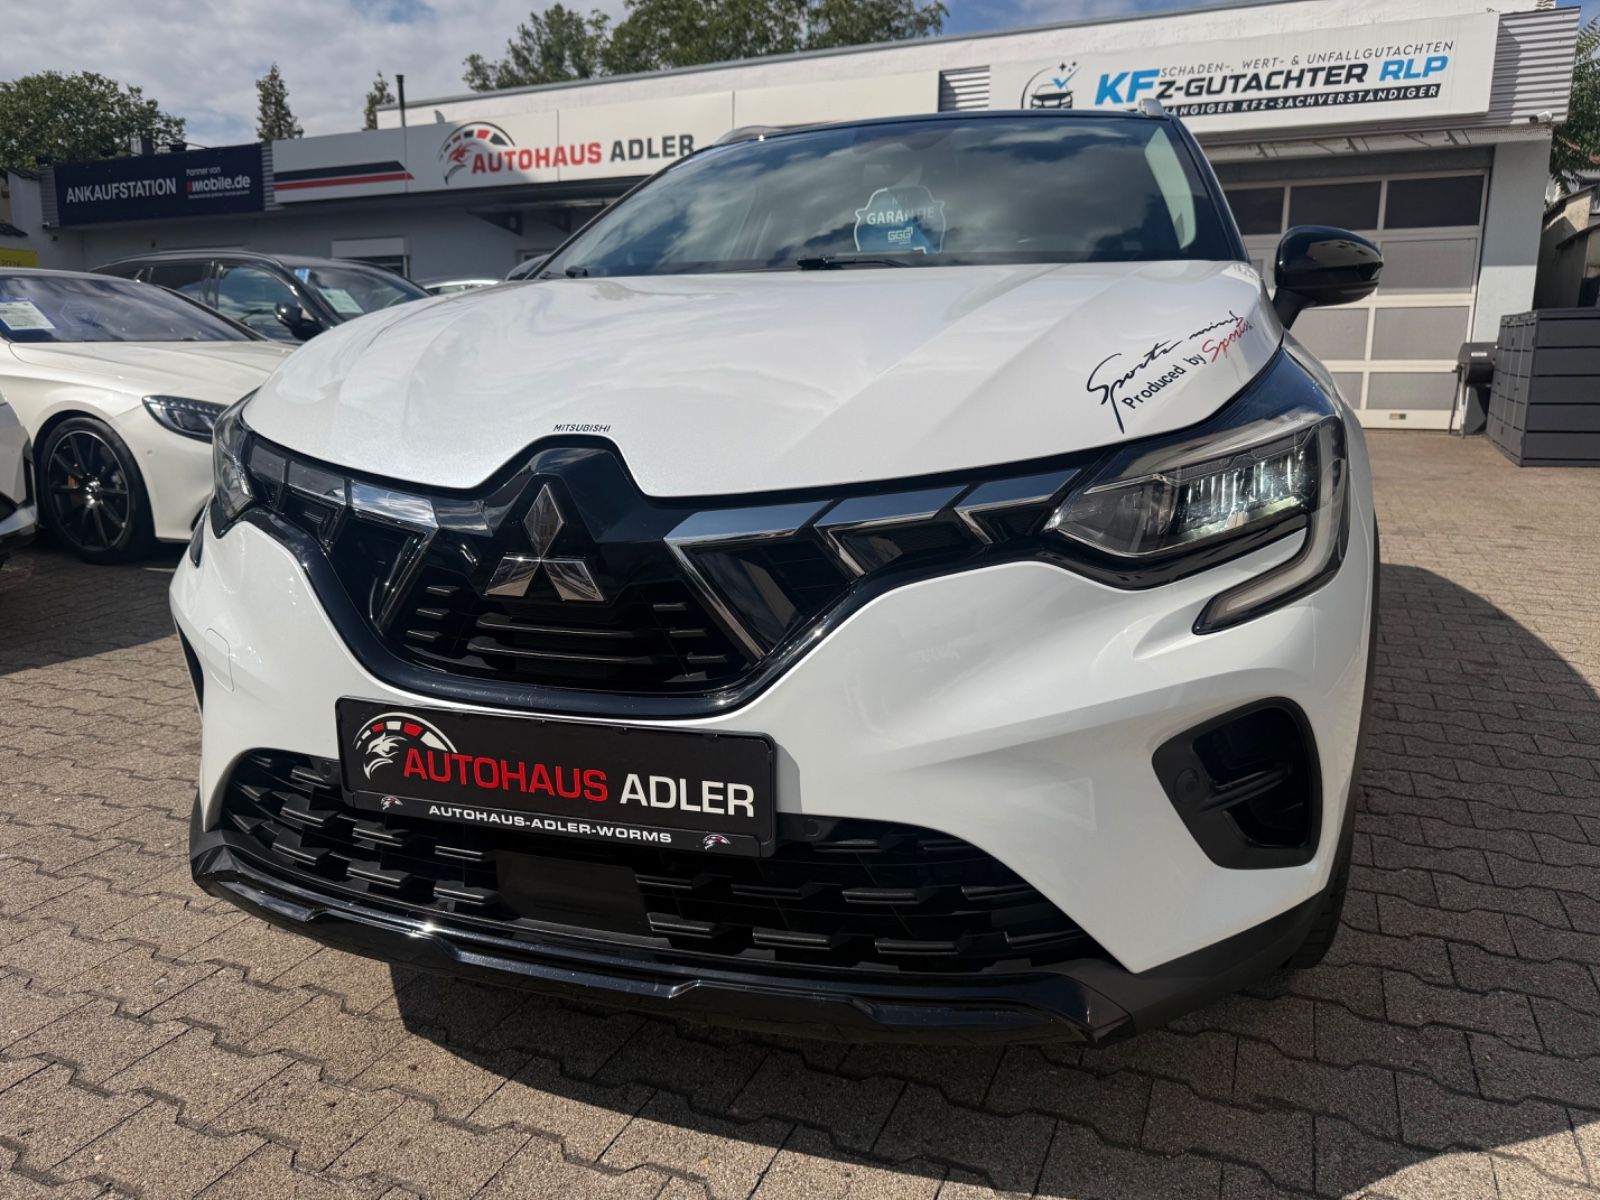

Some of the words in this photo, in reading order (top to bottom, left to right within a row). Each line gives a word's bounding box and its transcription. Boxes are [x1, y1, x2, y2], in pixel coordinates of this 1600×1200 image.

[1242, 56, 1285, 70] WERT-
[1291, 55, 1300, 66] &
[1307, 40, 1454, 65] UNFALLGUTACHTEN
[1379, 55, 1449, 82] RLP
[1241, 85, 1438, 112] KFZ-SACHVERSTÄNDIGER
[471, 142, 603, 174] AUTOHAUS
[609, 133, 695, 162] ADLER
[66, 177, 177, 203] ANKAUFSTATION
[191, 174, 251, 193] mobile.de
[1121, 364, 1188, 410] Produced
[1182, 353, 1207, 366] by
[553, 423, 612, 433] MITSUBISHI
[403, 747, 609, 802] AUTOHAUS
[619, 773, 756, 818] ADLER
[428, 805, 673, 844] AUTOHAUS-ADLER-WORMS
